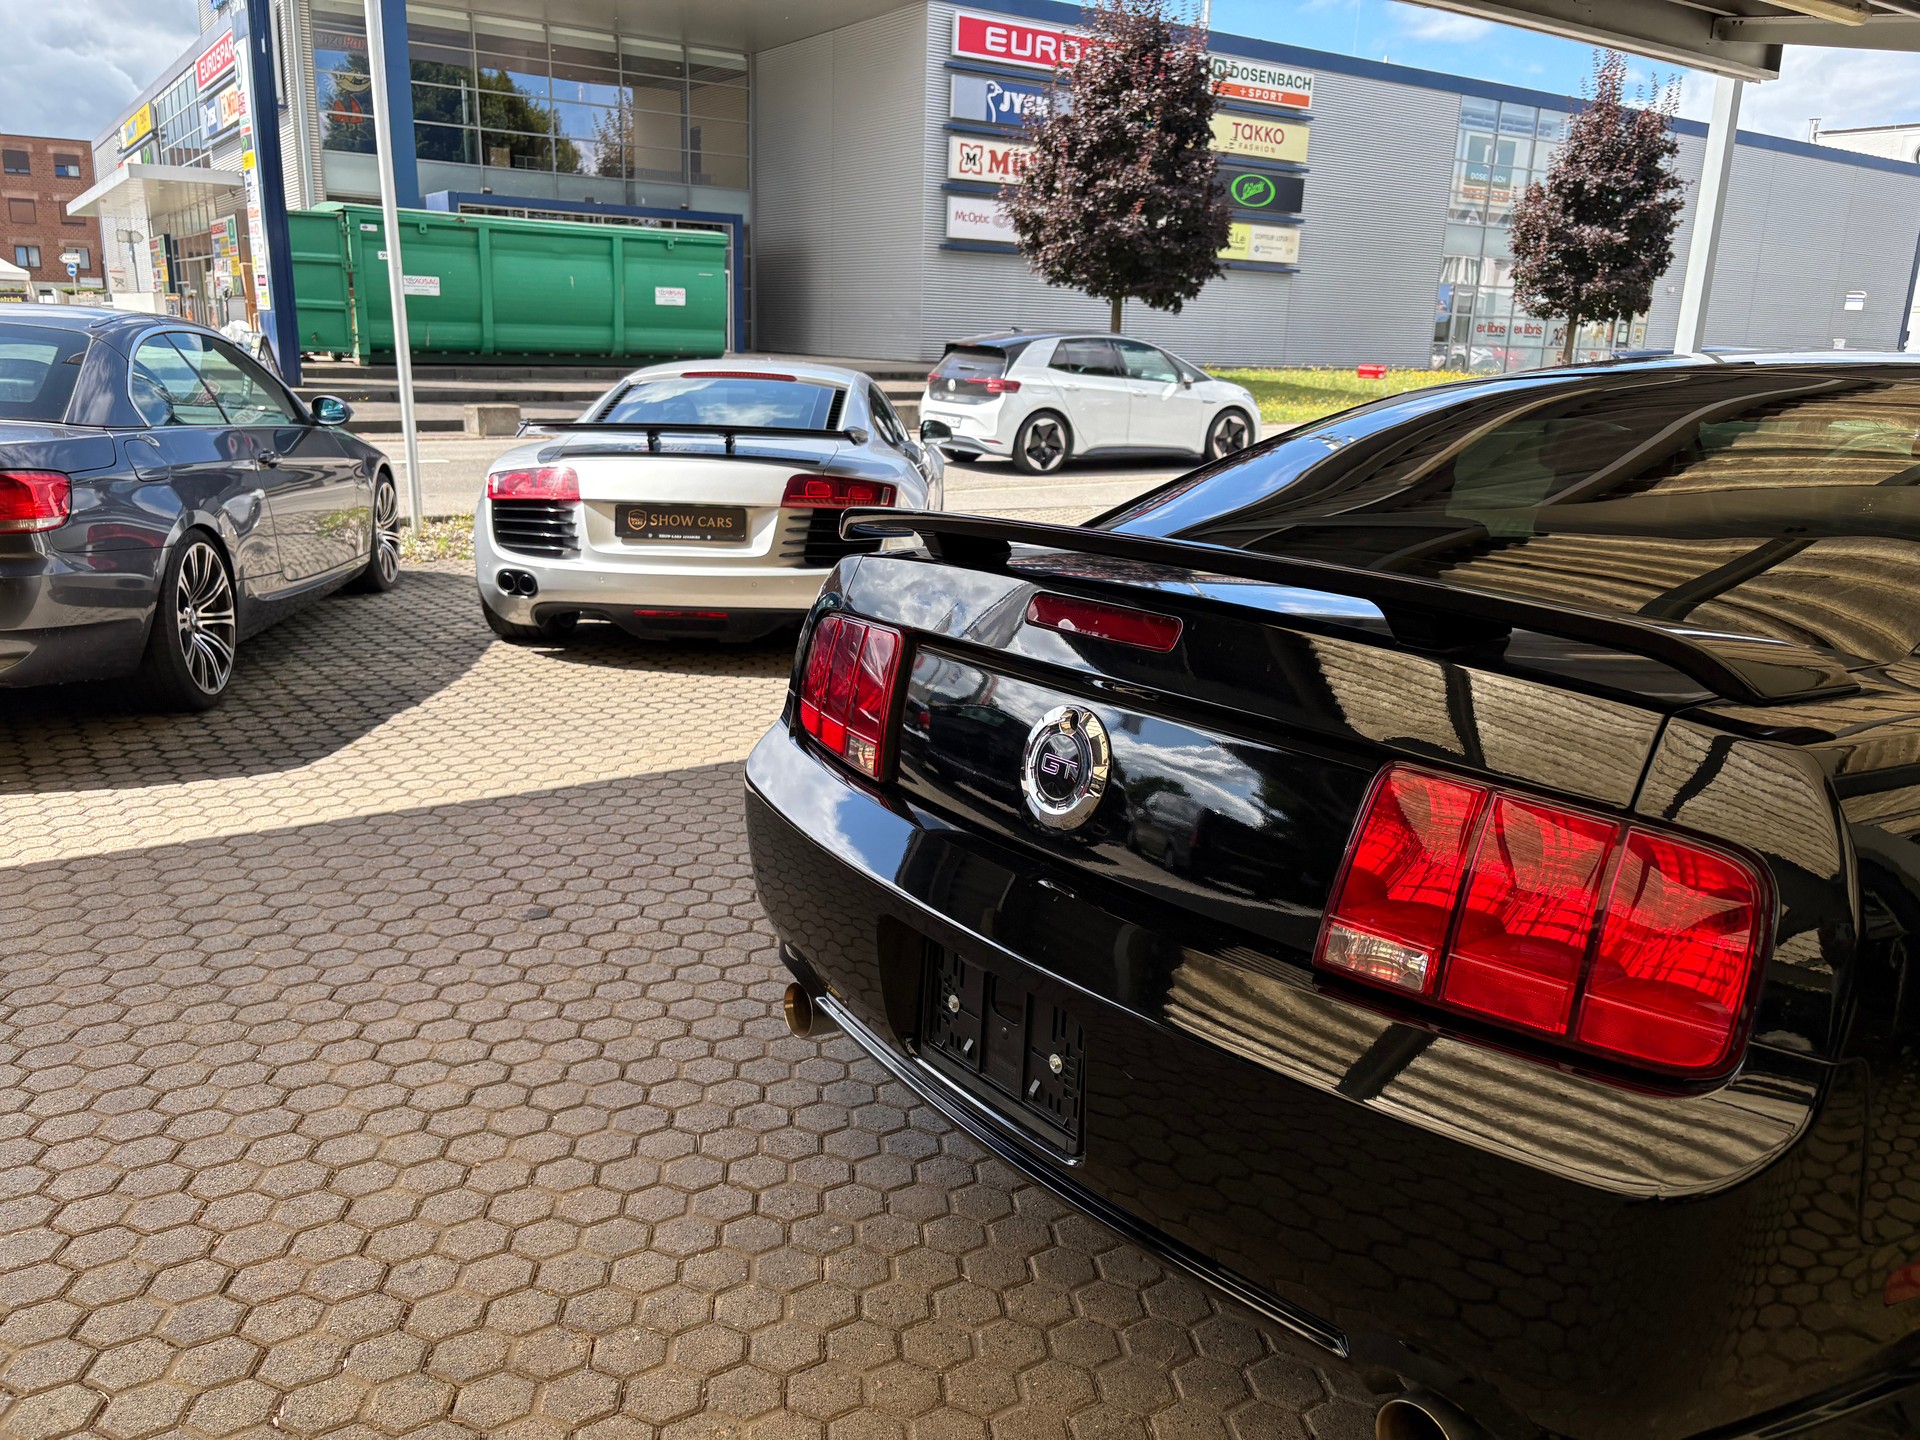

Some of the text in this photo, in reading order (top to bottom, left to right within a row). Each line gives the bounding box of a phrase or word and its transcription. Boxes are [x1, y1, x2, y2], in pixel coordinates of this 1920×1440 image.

[985, 26, 1081, 63] EURO
[1230, 65, 1312, 91] DOSENBACH
[1238, 142, 1276, 153] FASHION
[650, 513, 733, 529] SHOW CARS
[1041, 752, 1078, 779] GT
